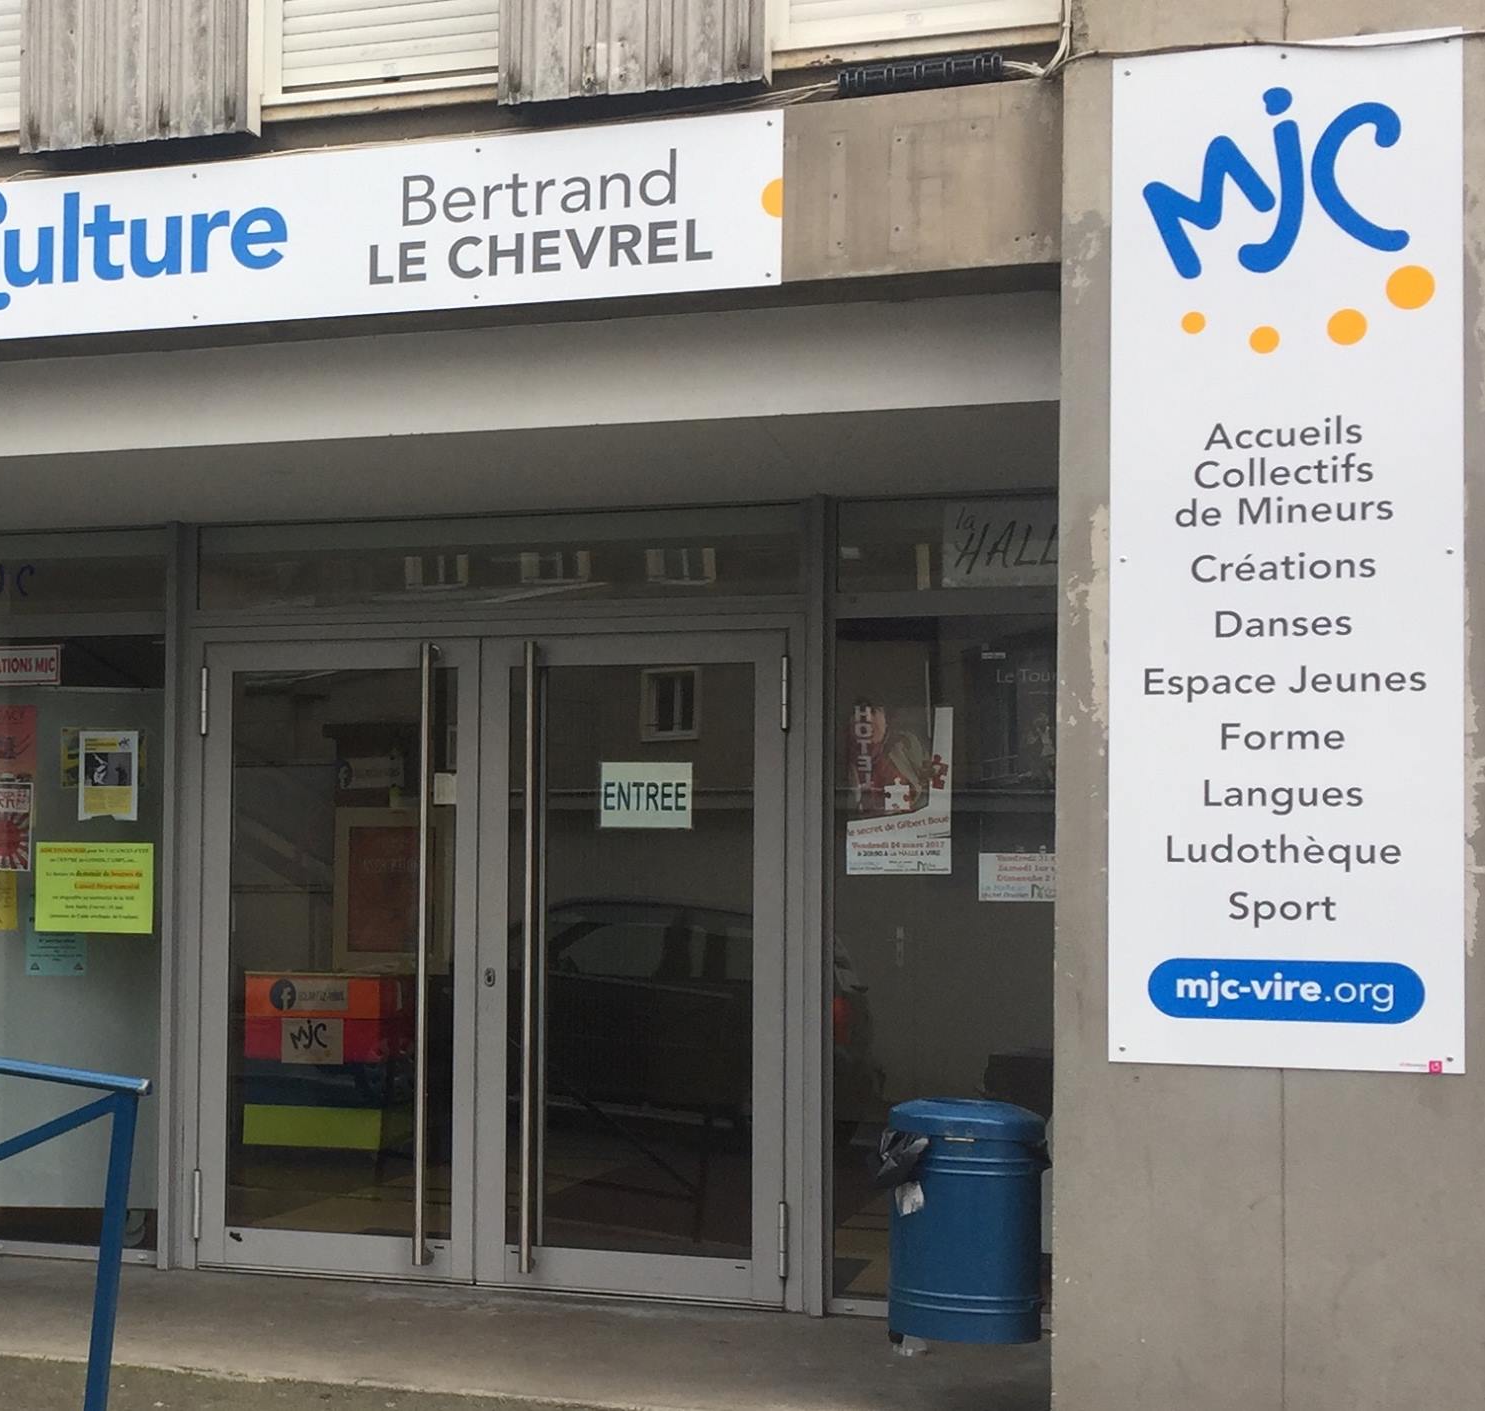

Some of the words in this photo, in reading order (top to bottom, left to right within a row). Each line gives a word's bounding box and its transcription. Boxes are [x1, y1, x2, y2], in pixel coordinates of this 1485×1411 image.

[402, 148, 677, 226] Bertrand
[369, 240, 427, 285] LE
[447, 218, 713, 279] CHEVREL
[1204, 415, 1363, 450] Accueils
[1194, 453, 1374, 489] Collectifs
[1175, 499, 1222, 527] de
[1238, 496, 1394, 526] Mineurs
[1191, 552, 1376, 583] Créations
[1214, 609, 1352, 639] Danses
[35, 656, 55, 673] MJC
[1143, 667, 1276, 703] Espace
[1288, 665, 1427, 695] Jeunes
[1220, 723, 1345, 751] Forme
[603, 782, 687, 811] ENTREE
[1203, 779, 1364, 815] Langues
[1166, 834, 1401, 872] Ludothèque
[1228, 891, 1337, 928] Sport
[1176, 971, 1396, 1012] mjc-vire.org
